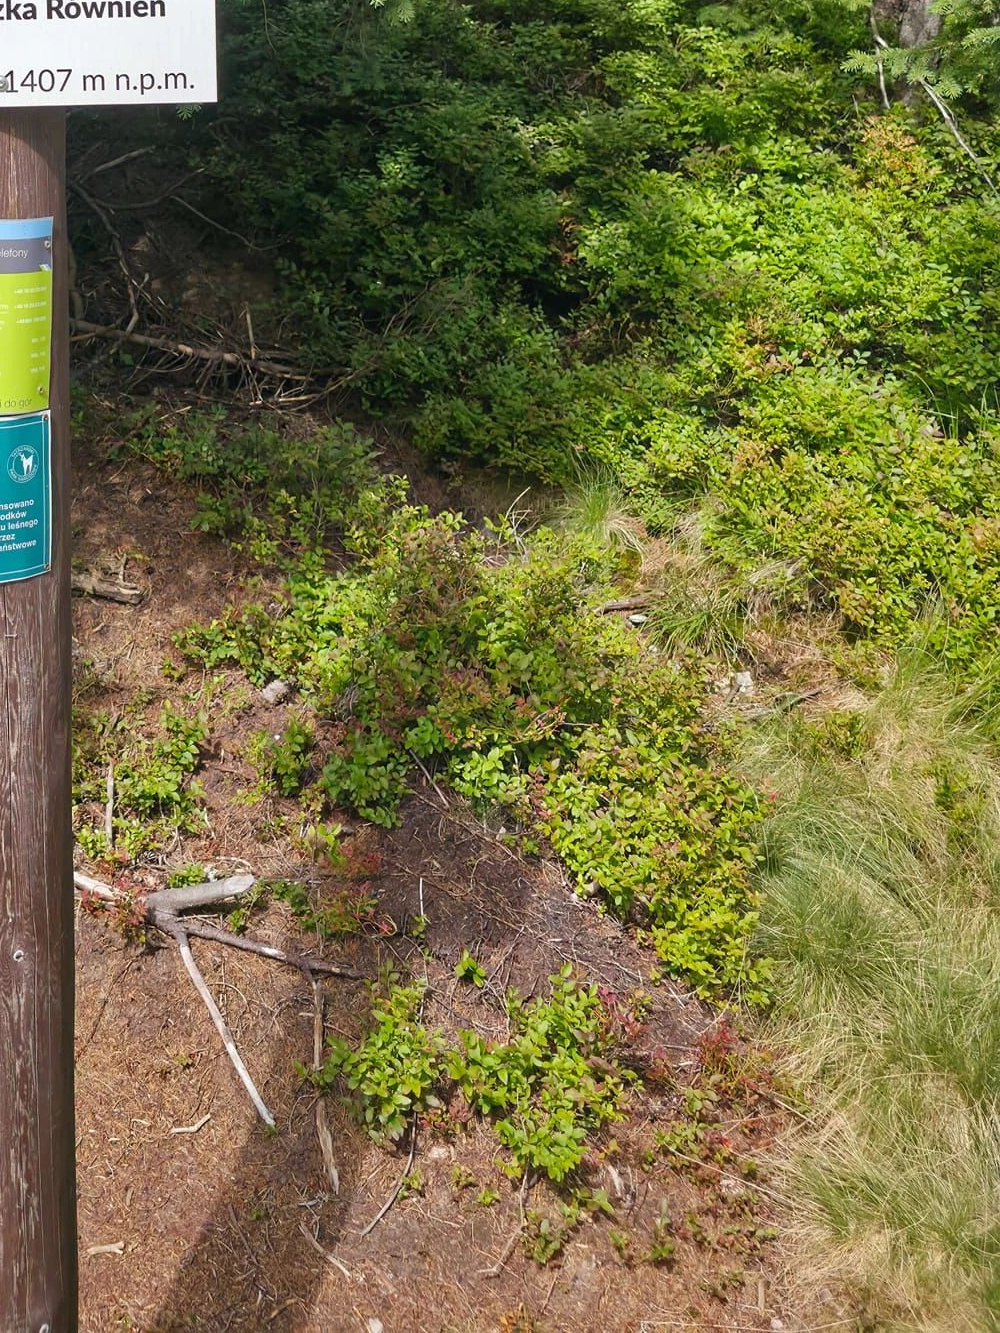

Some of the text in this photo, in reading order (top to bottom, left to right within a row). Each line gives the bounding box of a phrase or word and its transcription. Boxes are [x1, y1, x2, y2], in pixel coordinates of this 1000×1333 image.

[4, 68, 195, 96] 1407 m n.p.m.
[4, 398, 17, 408] do
[8, 519, 39, 530] leśnego
